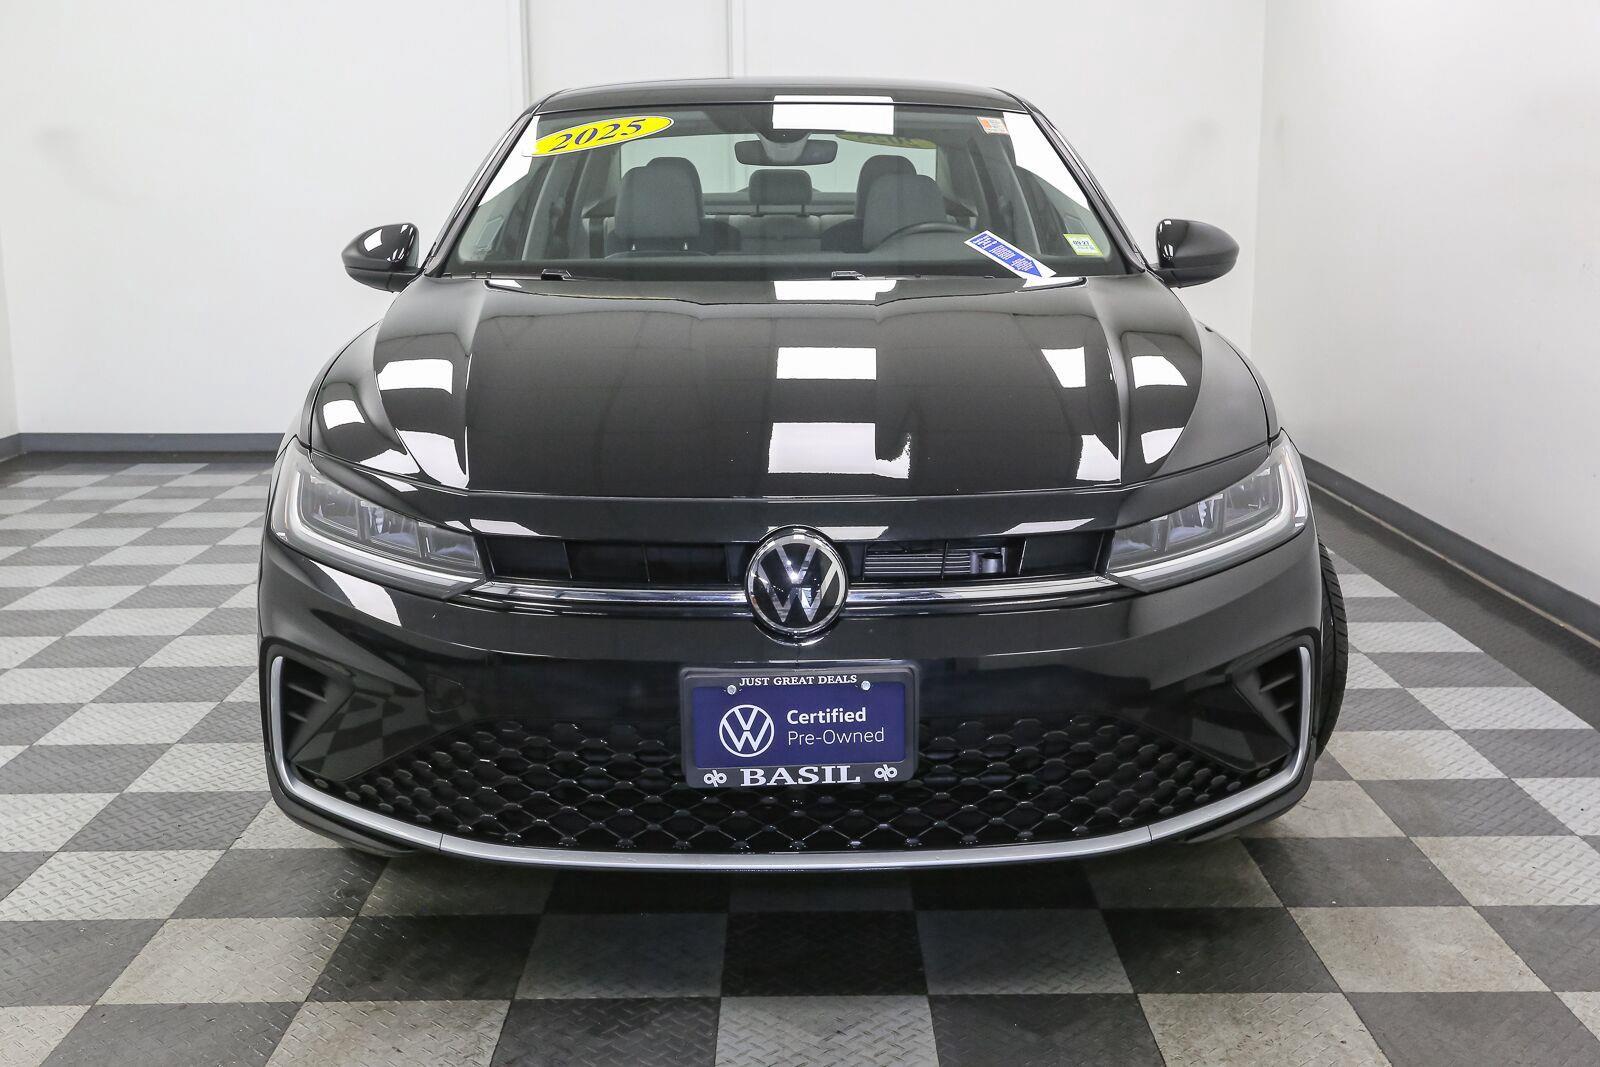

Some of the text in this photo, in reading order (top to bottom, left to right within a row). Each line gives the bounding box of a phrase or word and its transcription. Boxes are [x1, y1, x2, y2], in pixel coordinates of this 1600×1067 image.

[548, 118, 646, 152] 2025
[751, 537, 845, 627] VW
[739, 674, 858, 687] JUST GREAT DEALS
[786, 707, 867, 724] Certified
[720, 705, 773, 754] VW
[788, 727, 885, 746] Pre-Owned
[739, 765, 861, 787] BASIL
